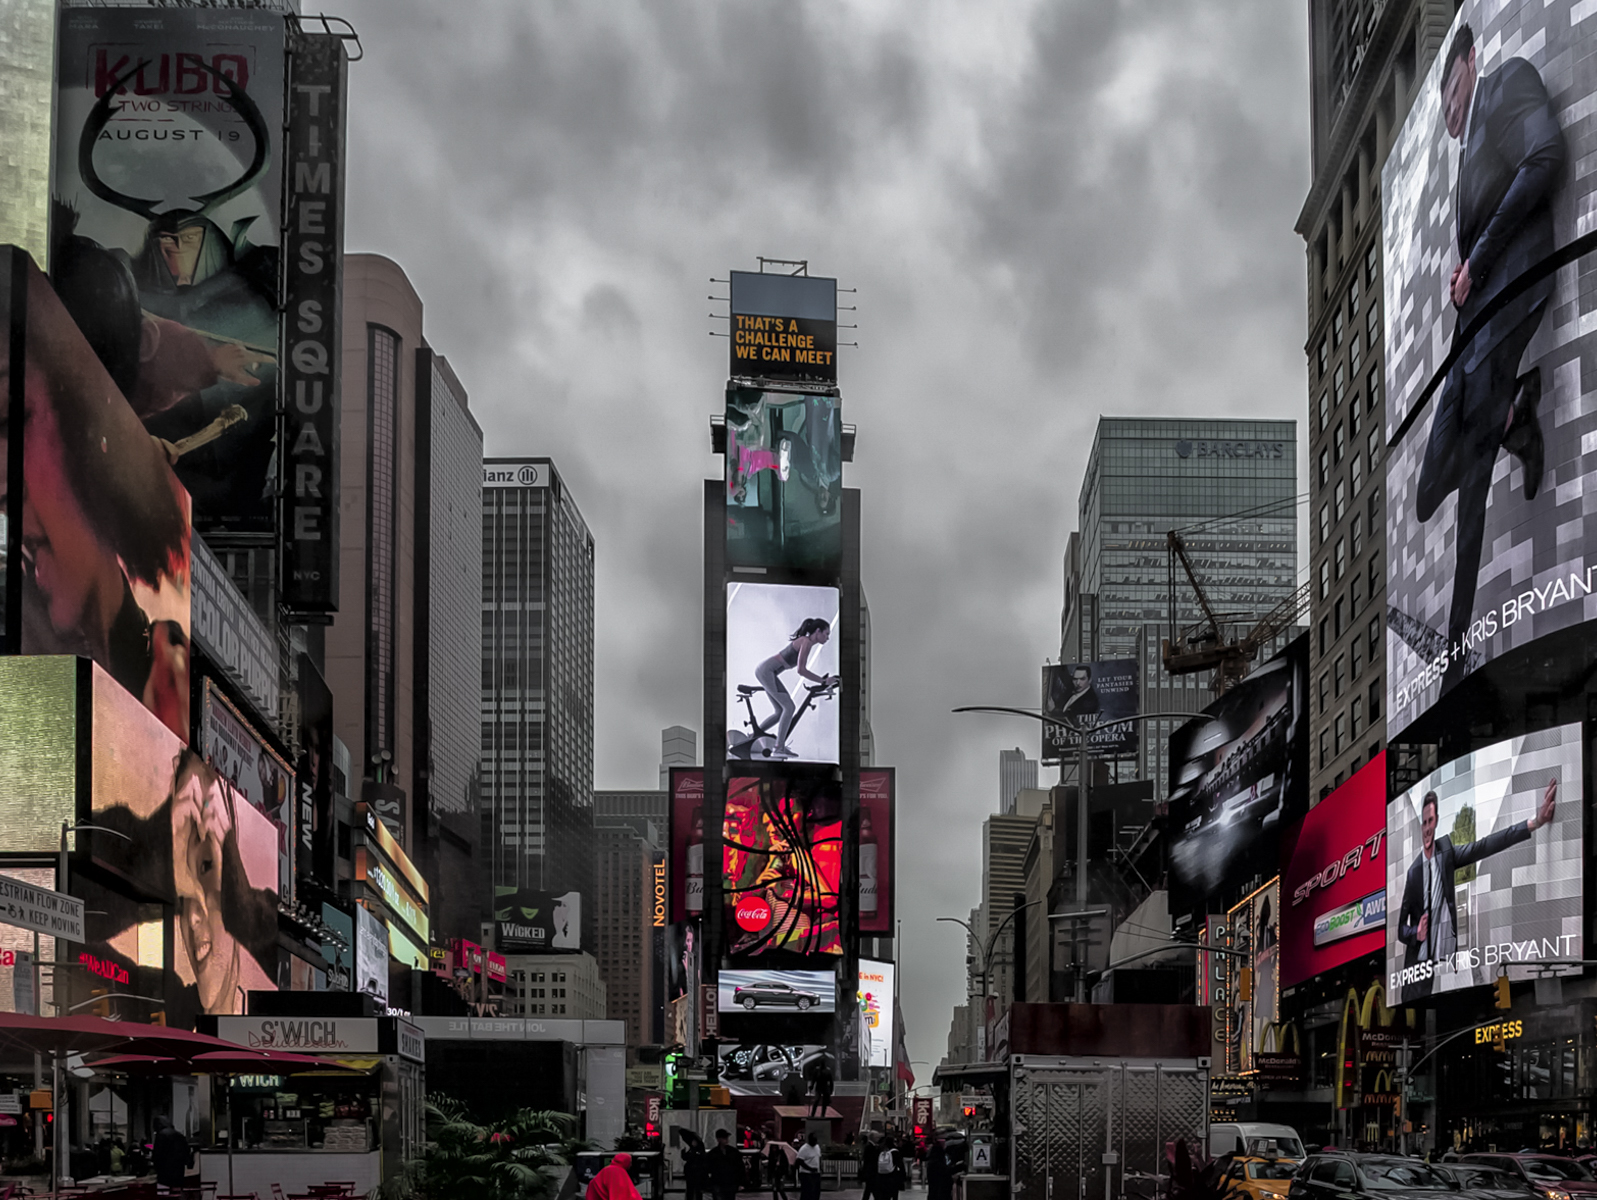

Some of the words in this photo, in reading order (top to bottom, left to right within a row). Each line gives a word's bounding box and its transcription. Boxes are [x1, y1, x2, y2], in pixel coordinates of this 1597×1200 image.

[94, 48, 249, 99] KUBO
[118, 100, 161, 112] TWO
[167, 100, 239, 113] STRING
[98, 129, 204, 141] AUGUST
[217, 130, 241, 142] 19
[294, 84, 332, 275] TIMES
[735, 315, 785, 332] THAT'S
[788, 319, 799, 333] A
[735, 330, 815, 349] CHALLENGE
[735, 344, 758, 360] WE
[761, 347, 791, 362] CAN
[795, 349, 833, 365] MEET
[290, 299, 330, 540] SQUARE
[1197, 441, 1284, 459] BARCLAYS
[293, 570, 320, 581] NYC
[197, 586, 239, 674] COLOR
[1396, 650, 1449, 712] EXPRESS
[1461, 610, 1497, 656] KRIS
[1077, 714, 1099, 723] THE
[1051, 736, 1066, 746] OF
[1090, 733, 1126, 743] OPERA
[302, 782, 313, 851] NEW
[1292, 827, 1386, 907] SPORT
[653, 859, 666, 927] NOVOTEL
[36, 894, 59, 910] FLOW
[60, 900, 80, 918] ZONE
[29, 909, 49, 926] KEEP
[51, 916, 81, 936] MOVING
[1390, 959, 1433, 990] EXPRESS
[1445, 948, 1481, 972] KRIS
[1484, 934, 1577, 966] BRYANT
[1214, 925, 1227, 1042] PALACE
[261, 1020, 336, 1045] S'WICH
[917, 1100, 930, 1125] tkts
[976, 1148, 987, 1161] A
